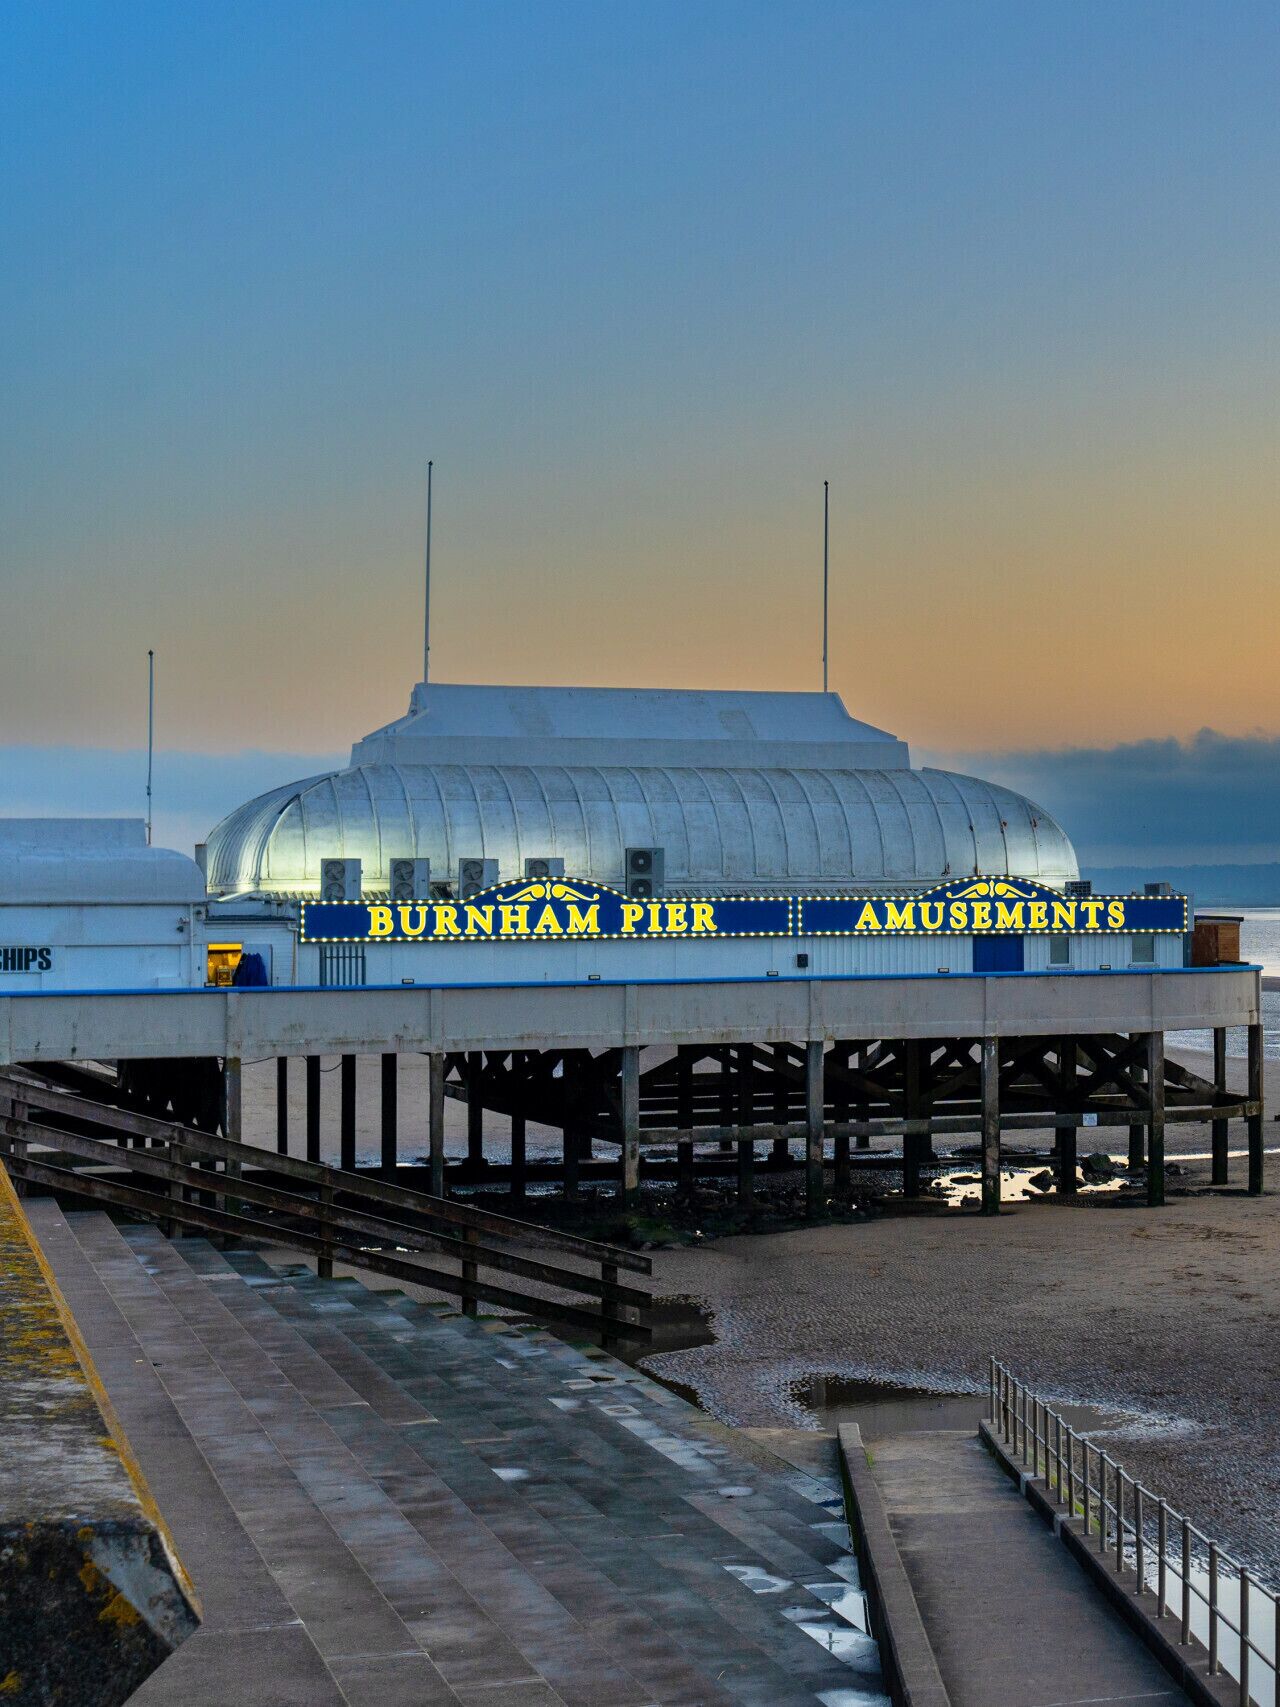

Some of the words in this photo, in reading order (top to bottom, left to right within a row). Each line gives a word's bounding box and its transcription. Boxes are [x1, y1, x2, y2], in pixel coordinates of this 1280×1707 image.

[367, 903, 601, 936] BURNHAM
[620, 902, 717, 933] PIER
[854, 900, 1126, 930] AMUSEMENTS
[0, 947, 52, 971] HIPS
